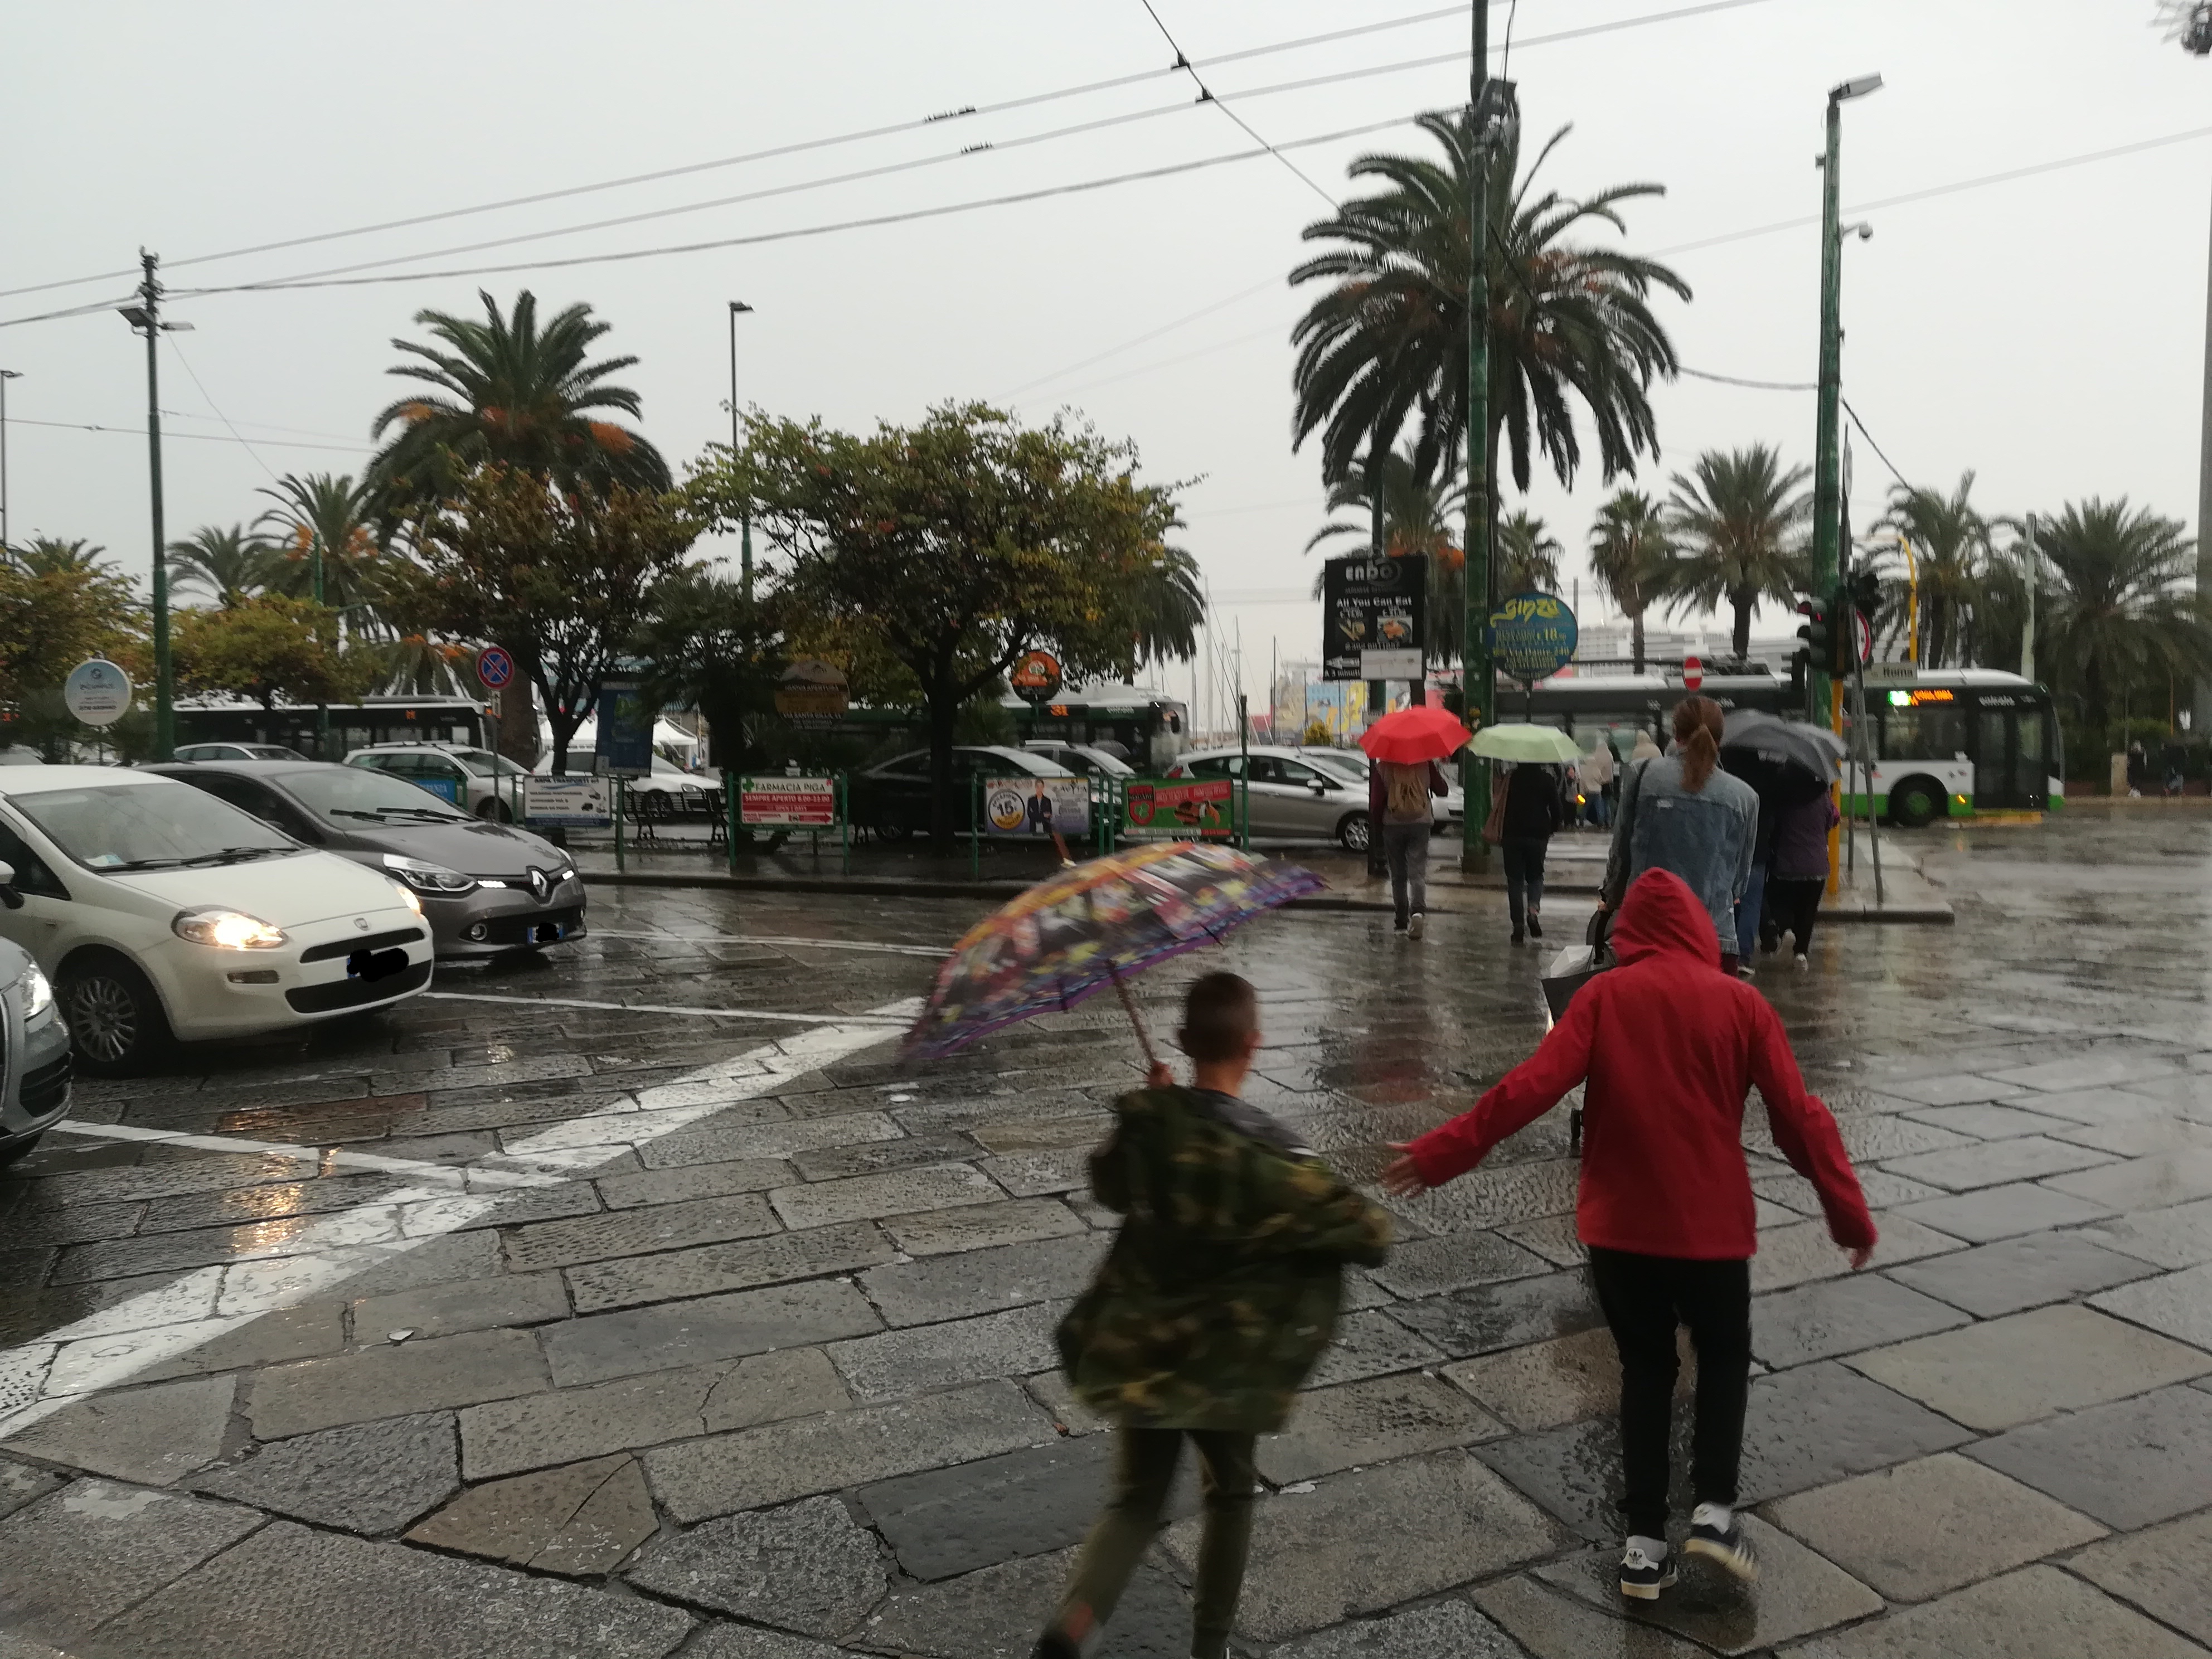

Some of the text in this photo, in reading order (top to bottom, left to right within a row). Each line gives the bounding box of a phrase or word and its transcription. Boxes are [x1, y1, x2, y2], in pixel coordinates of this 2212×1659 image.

[1337, 598, 1350, 607] All
[1352, 597, 1371, 607] You
[1373, 596, 1393, 607] Can
[755, 783, 802, 792] FARMACIA
